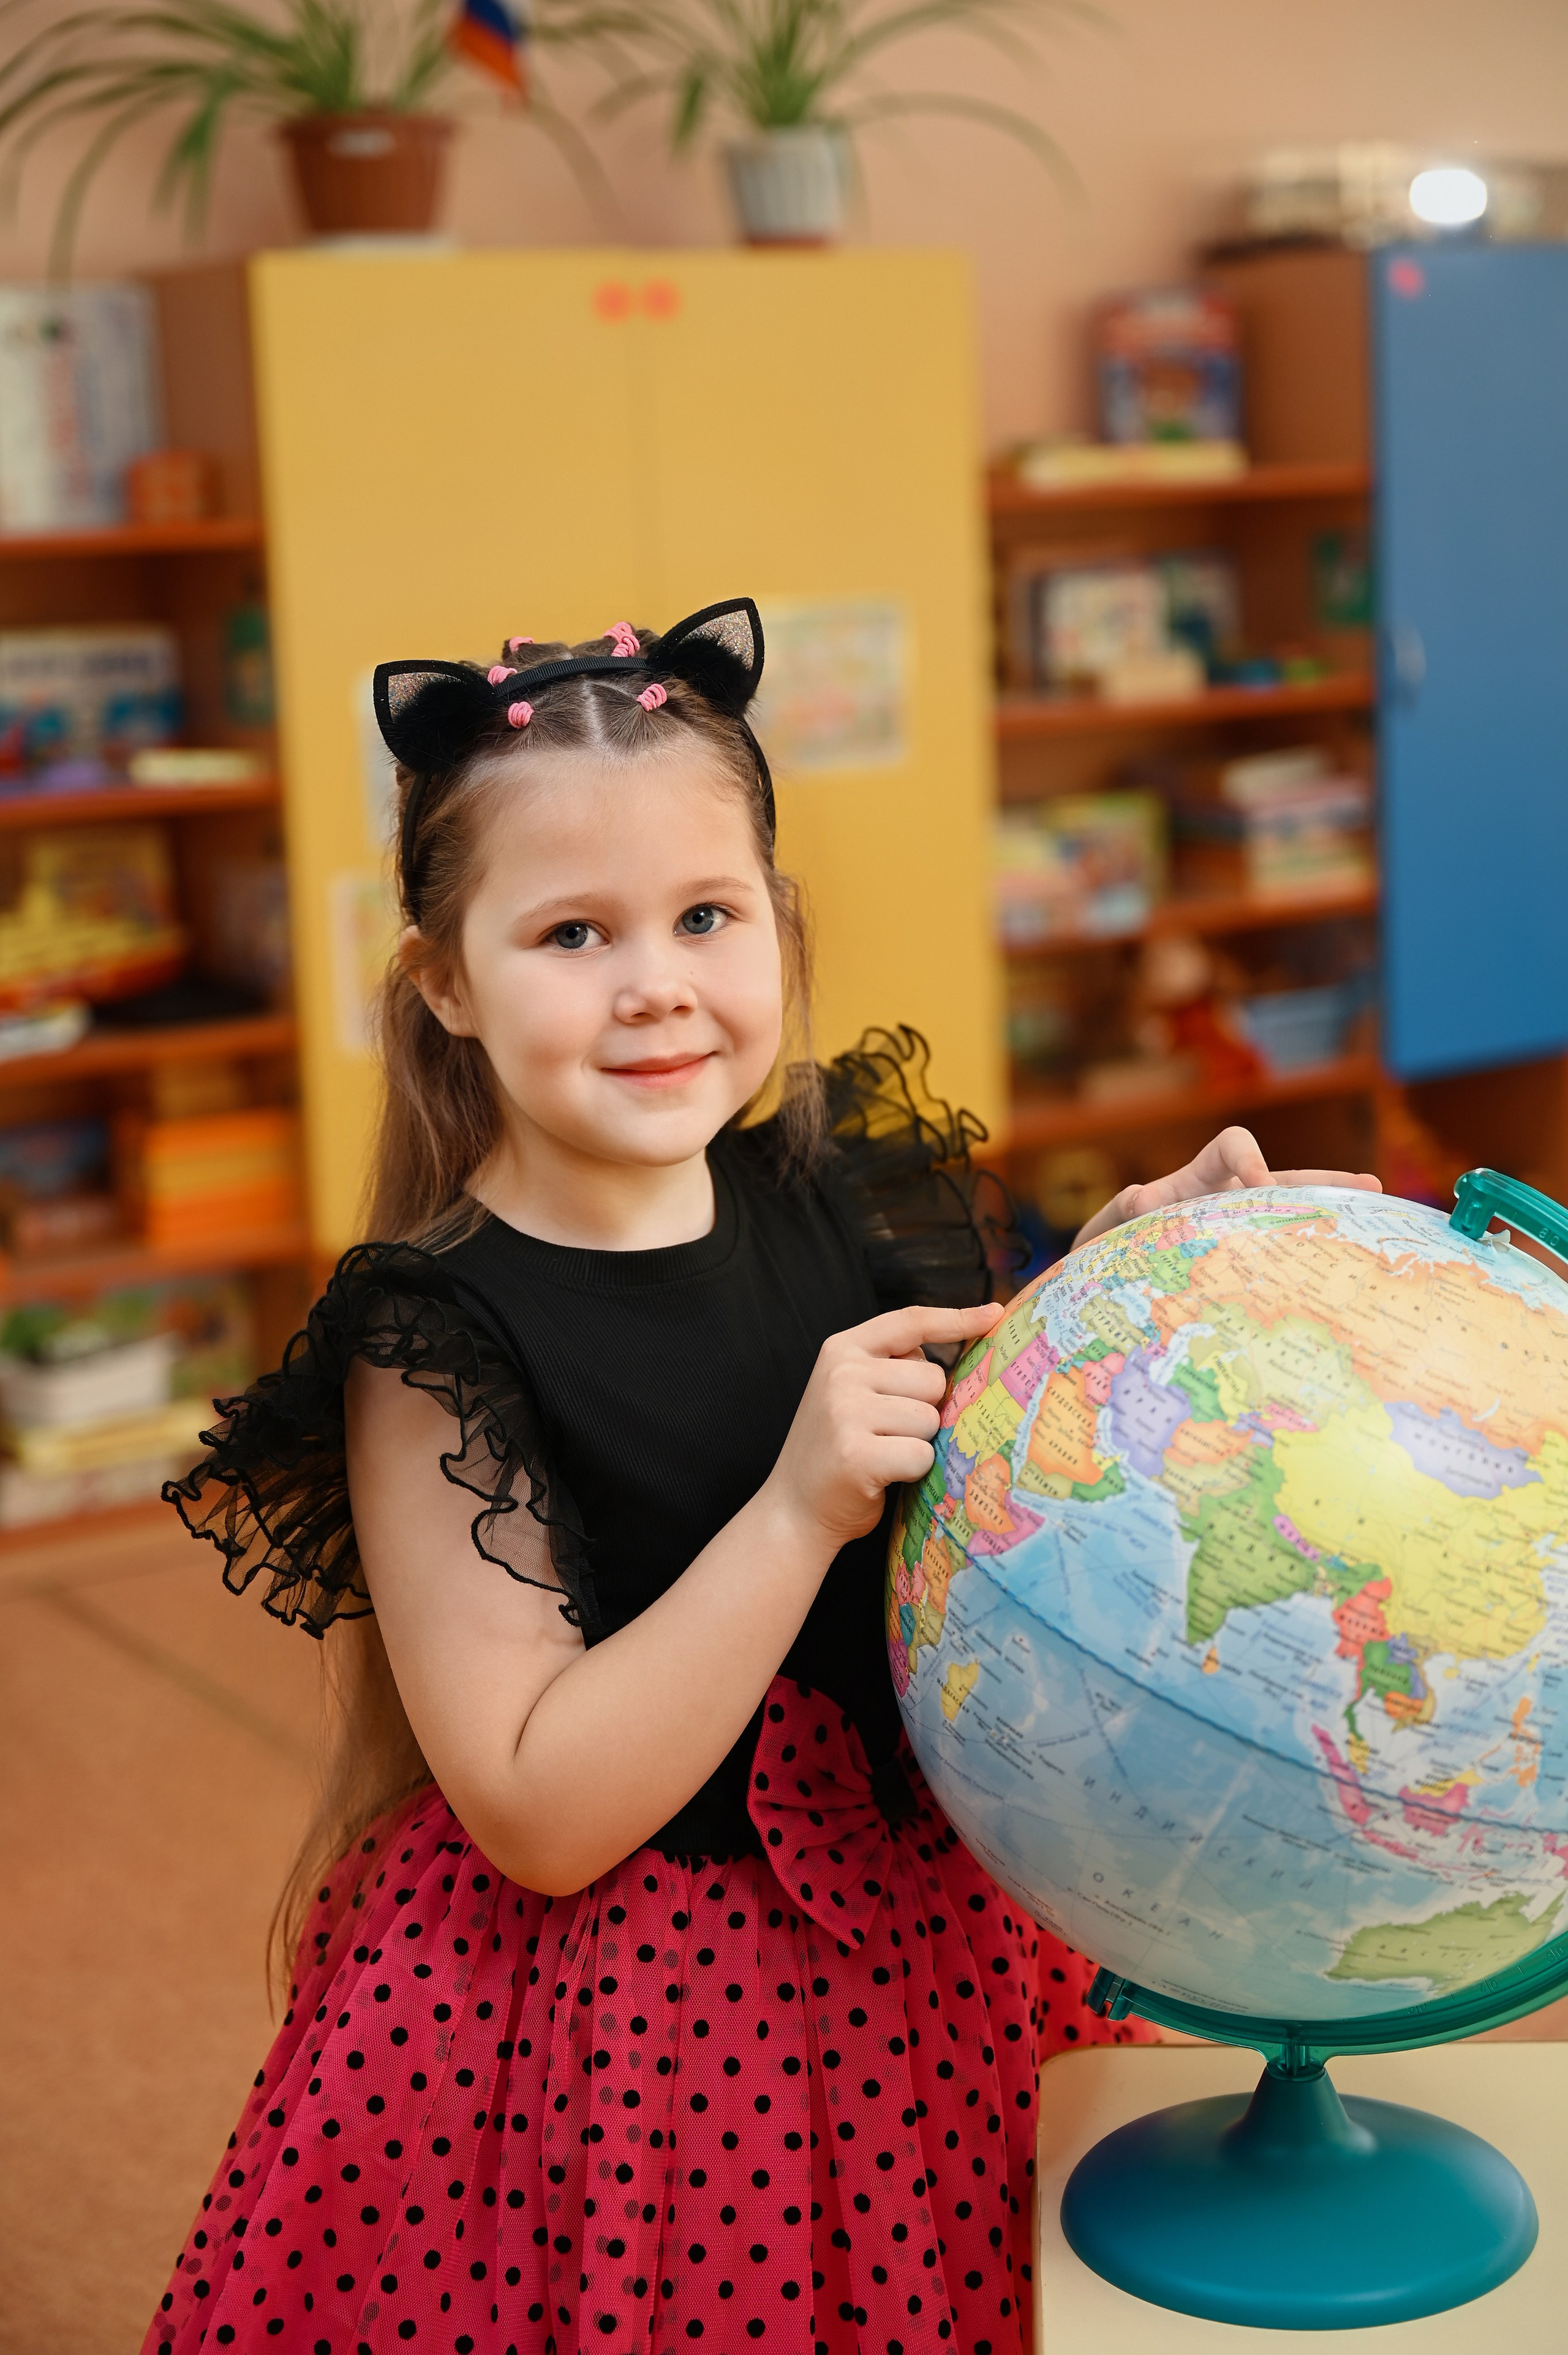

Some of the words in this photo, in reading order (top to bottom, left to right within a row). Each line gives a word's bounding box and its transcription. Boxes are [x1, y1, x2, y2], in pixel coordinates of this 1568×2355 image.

[1538, 1228, 1561, 1246] 80
[1008, 1319, 1021, 1345] ЛИВИЯ
[1096, 1310, 1128, 1343] ТУРЦИЯ
[1010, 1361, 1036, 1389] ЕГИПЕТ
[1086, 1371, 1108, 1390] ИРАК
[976, 1399, 995, 1425] СУДАН
[1046, 1386, 1093, 1428] САУДОВСКАЯ
[1123, 1387, 1172, 1424] ИРАН
[1048, 1440, 1079, 1466] АРАВИЯ
[1414, 1432, 1515, 1475] МОНГОЛИЯ
[968, 1489, 1004, 1526] ЭФИОПИЯ
[952, 1516, 971, 1538] КЕНИЯ
[981, 1532, 1005, 1556] СОМАЛИ
[1207, 1522, 1296, 1573] ИНДИЯ
[924, 1545, 949, 1579] ТАНЗАНИЯ
[936, 1677, 970, 1714] МАДАГАСКАР
[1083, 1774, 1315, 1892] ИНДИЙСКИЙ
[1093, 1871, 1225, 1941] ОКЕАН
